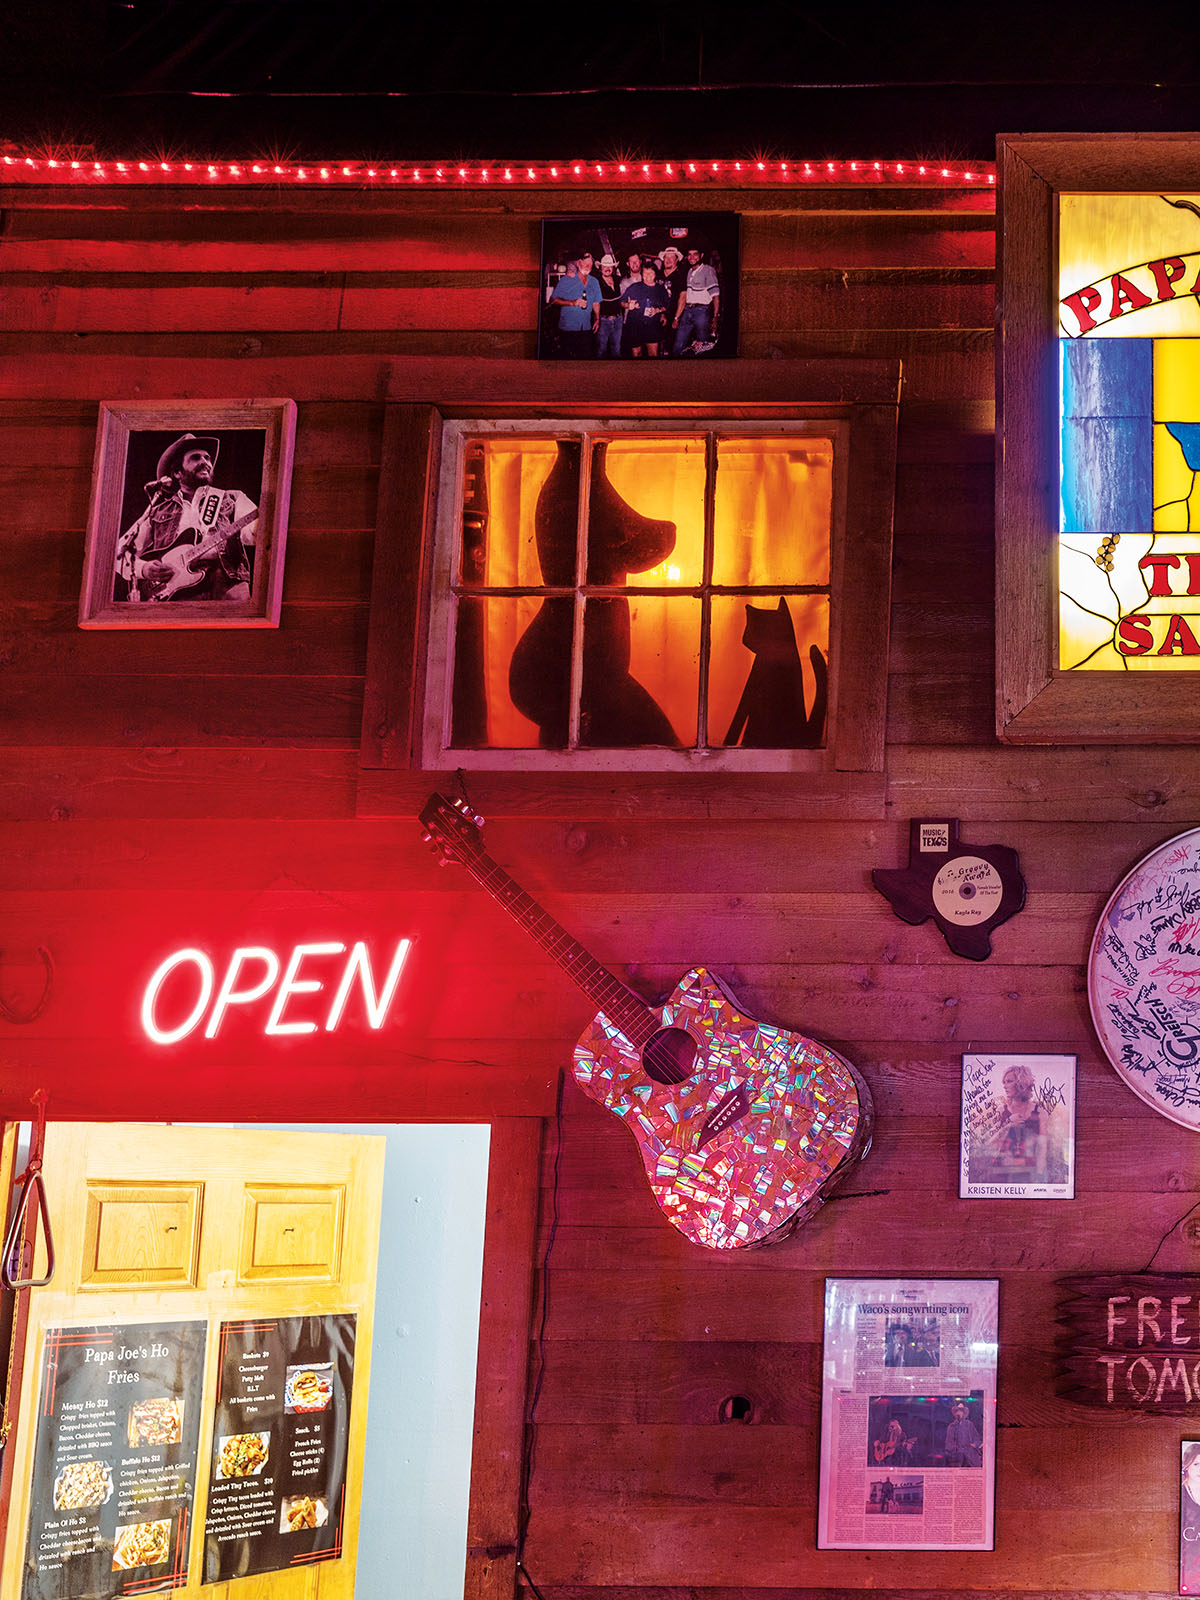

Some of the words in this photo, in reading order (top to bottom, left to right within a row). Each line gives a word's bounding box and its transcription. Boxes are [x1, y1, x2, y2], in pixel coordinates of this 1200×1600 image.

[958, 863, 990, 876] Groovy
[140, 938, 411, 1045] OPEN
[967, 1186, 1002, 1195] KRISTEN
[1004, 1186, 1027, 1195] KELLY
[858, 1304, 890, 1314] Waco's
[949, 1303, 969, 1314] icon
[85, 1348, 114, 1366] Papa
[118, 1346, 148, 1361] Joe's
[151, 1343, 169, 1358] Ho
[107, 1370, 140, 1385] Fries
[85, 1401, 96, 1409] Ho
